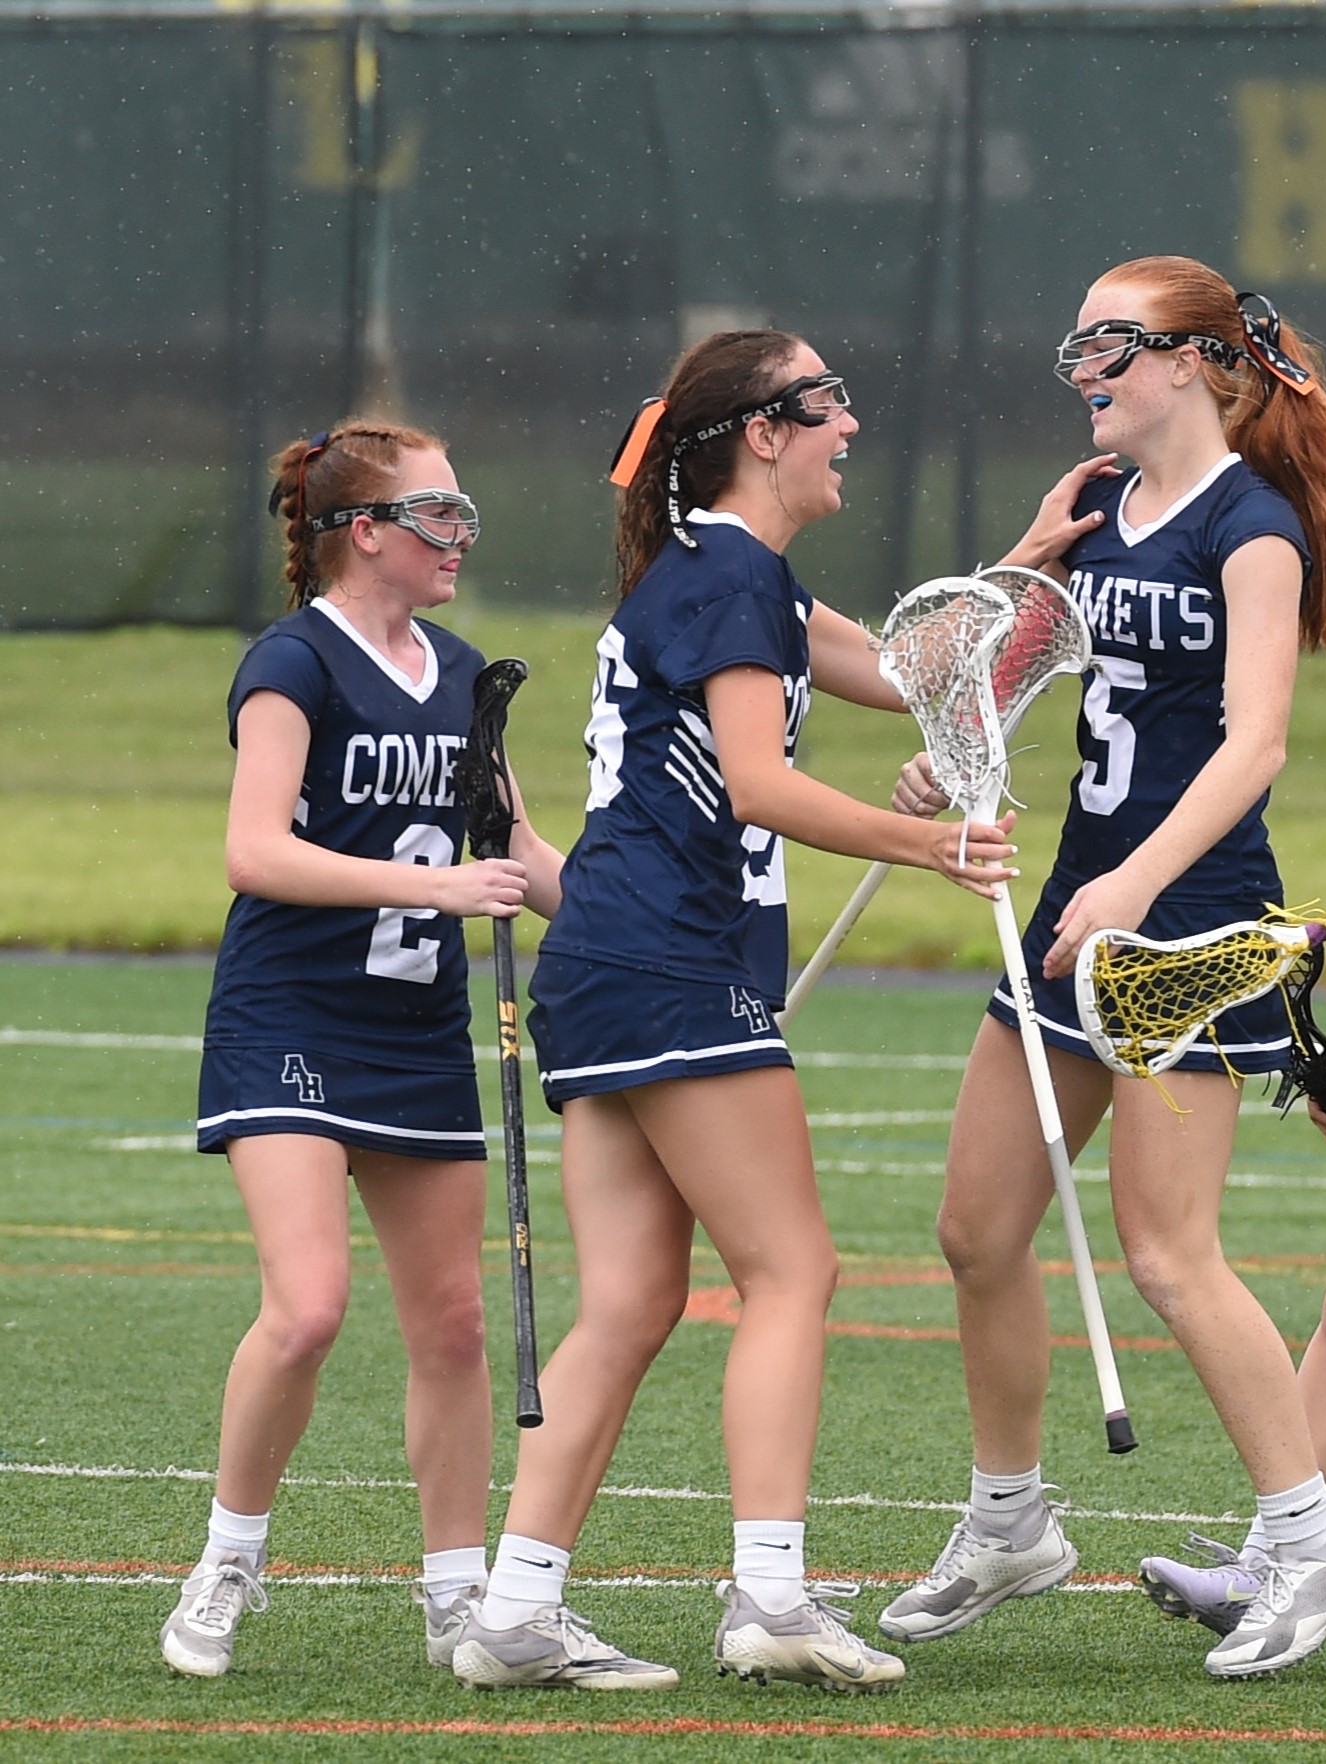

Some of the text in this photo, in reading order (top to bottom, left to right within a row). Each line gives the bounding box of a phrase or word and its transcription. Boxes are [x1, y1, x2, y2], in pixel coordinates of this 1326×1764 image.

[697, 420, 734, 441] GAIT
[668, 460, 681, 491] GAIT
[668, 497, 682, 524] GAIT
[1078, 655, 1148, 816] 5
[366, 823, 455, 985] 2
[499, 999, 518, 1061] STX
[729, 985, 771, 1034] AH
[281, 1053, 326, 1104] AH
